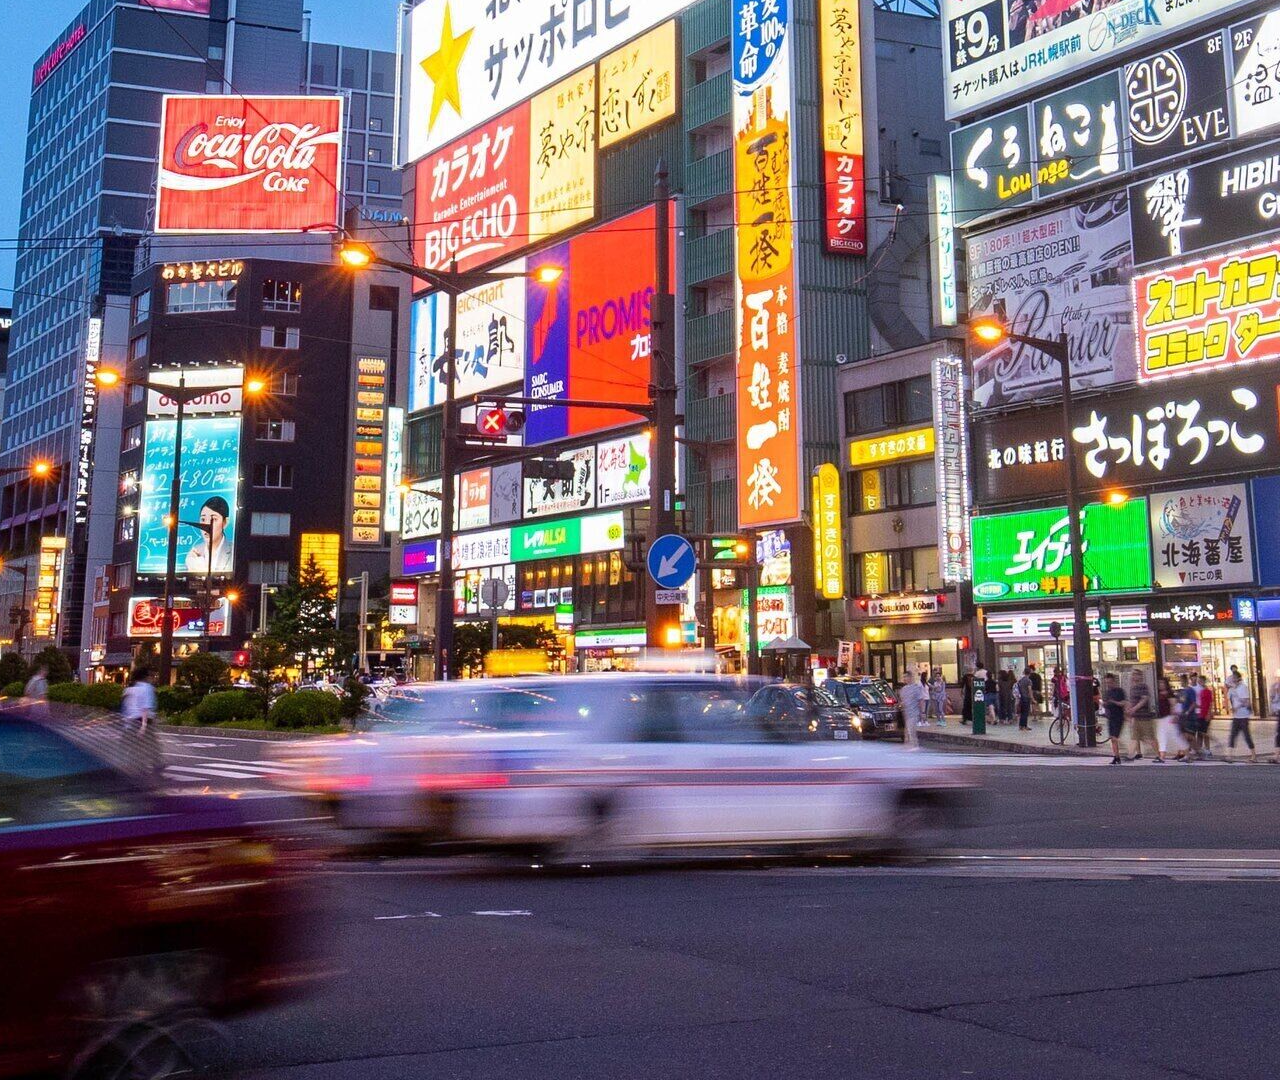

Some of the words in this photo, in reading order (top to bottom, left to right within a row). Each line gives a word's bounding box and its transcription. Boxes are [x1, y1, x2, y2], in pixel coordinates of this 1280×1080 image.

[739, 1, 759, 79] 革命
[954, 17, 967, 65] 地下鉄
[1234, 28, 1253, 51] 2F
[952, 60, 1020, 100] チケット購入は
[1020, 34, 1082, 72] JR札幌駅前
[175, 122, 320, 170] Coca-Cola
[215, 115, 246, 128] Enjoy
[966, 102, 1091, 190] くろねこ
[1182, 107, 1231, 147] EVE
[262, 170, 310, 192] Coke
[430, 124, 514, 202] カラオケ
[998, 159, 1072, 200] Lounge
[459, 178, 508, 211] Entertainment
[746, 132, 779, 274] 百姓一揆
[835, 155, 856, 234] カラオケ
[1145, 167, 1202, 257] 響
[424, 221, 460, 270] BIG
[461, 193, 518, 246] ECHO
[577, 286, 655, 350] PROMIS
[1145, 319, 1231, 372] コミック
[531, 372, 548, 387] SMBC
[531, 380, 565, 399] CONSUMER
[746, 289, 782, 511] 百姓一揆
[777, 351, 791, 432] 麦焼酎
[869, 435, 926, 458] すすきの交番
[987, 437, 1066, 470] 北の味紀行
[1072, 387, 1266, 478] さっぽろっこ
[824, 492, 840, 596] すすきの交番
[1161, 535, 1245, 568] 北海番屋
[1188, 569, 1223, 582] 1Fこの奥
[878, 601, 910, 614] Susukino
